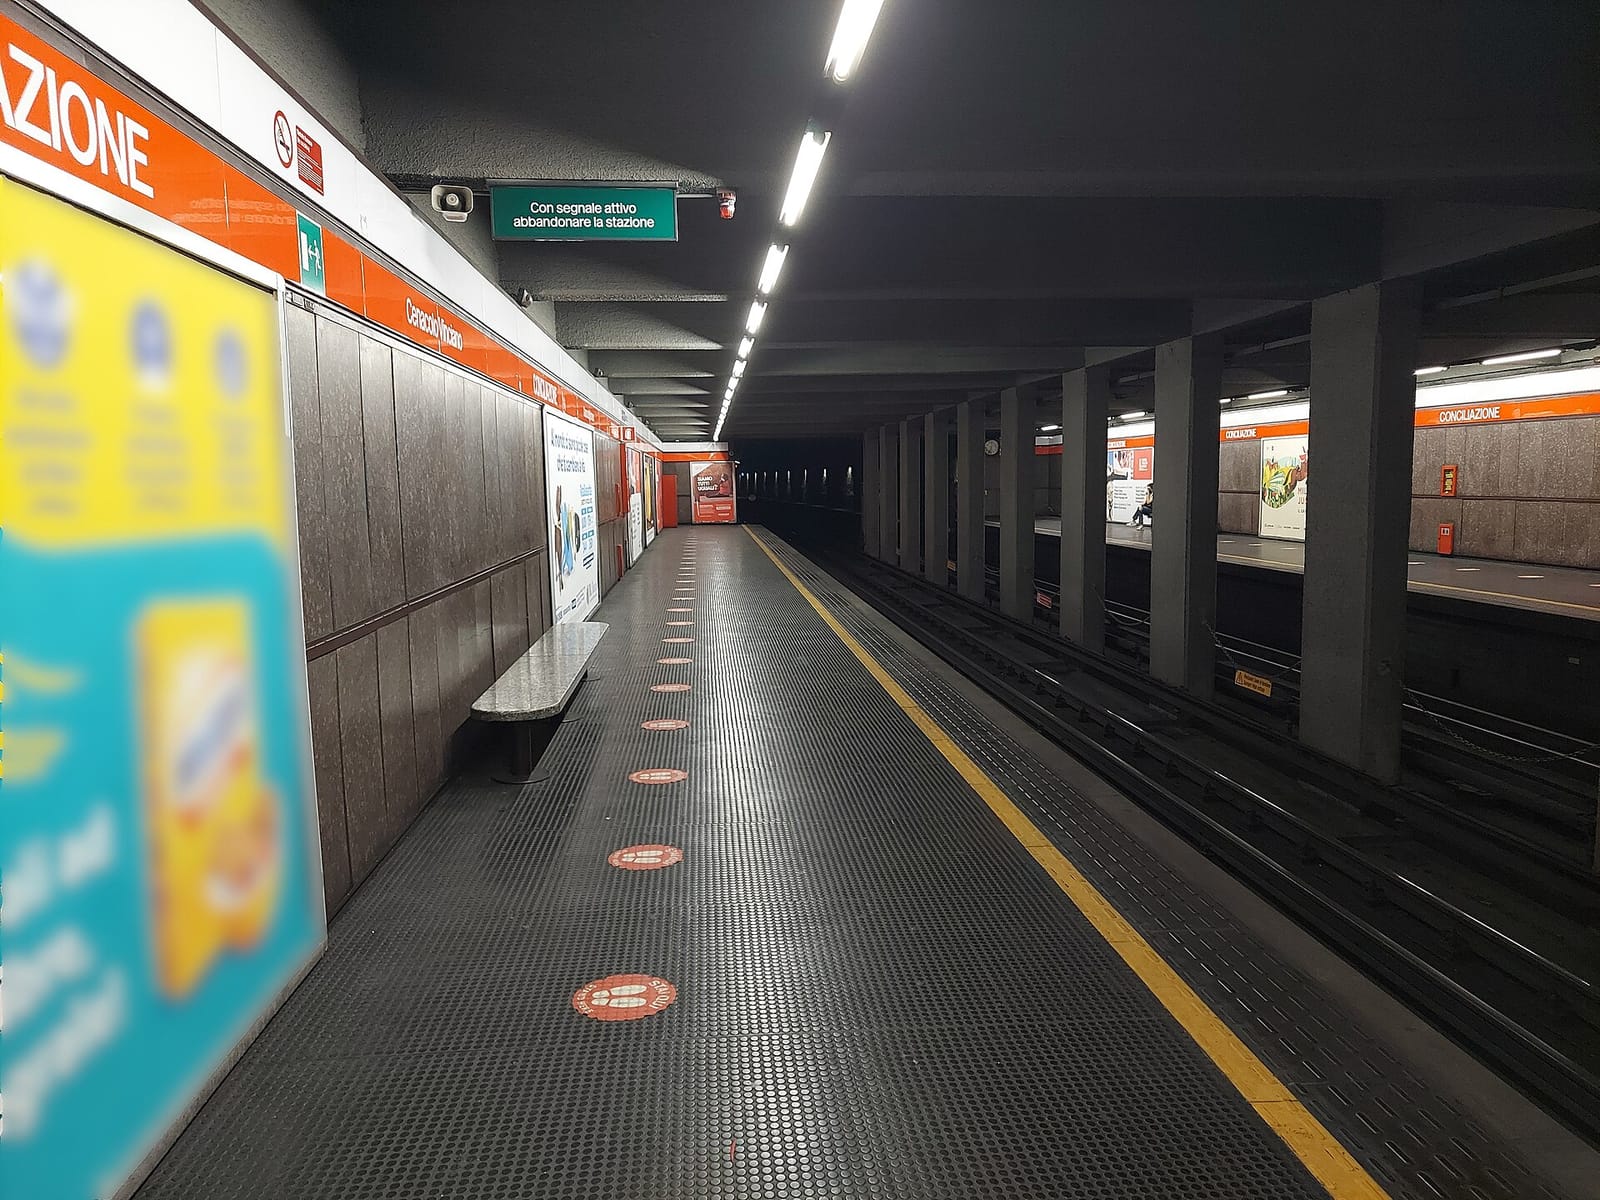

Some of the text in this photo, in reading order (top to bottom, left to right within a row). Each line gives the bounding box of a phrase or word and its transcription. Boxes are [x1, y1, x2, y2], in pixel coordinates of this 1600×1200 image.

[530, 202, 637, 215] Con segnale attivo
[513, 216, 655, 228] abbandonare la stazione
[406, 297, 463, 351] Cenacolo Vinciano
[1440, 407, 1501, 422] CONCILIAZIONE
[648, 979, 671, 1010] STAI QUI
